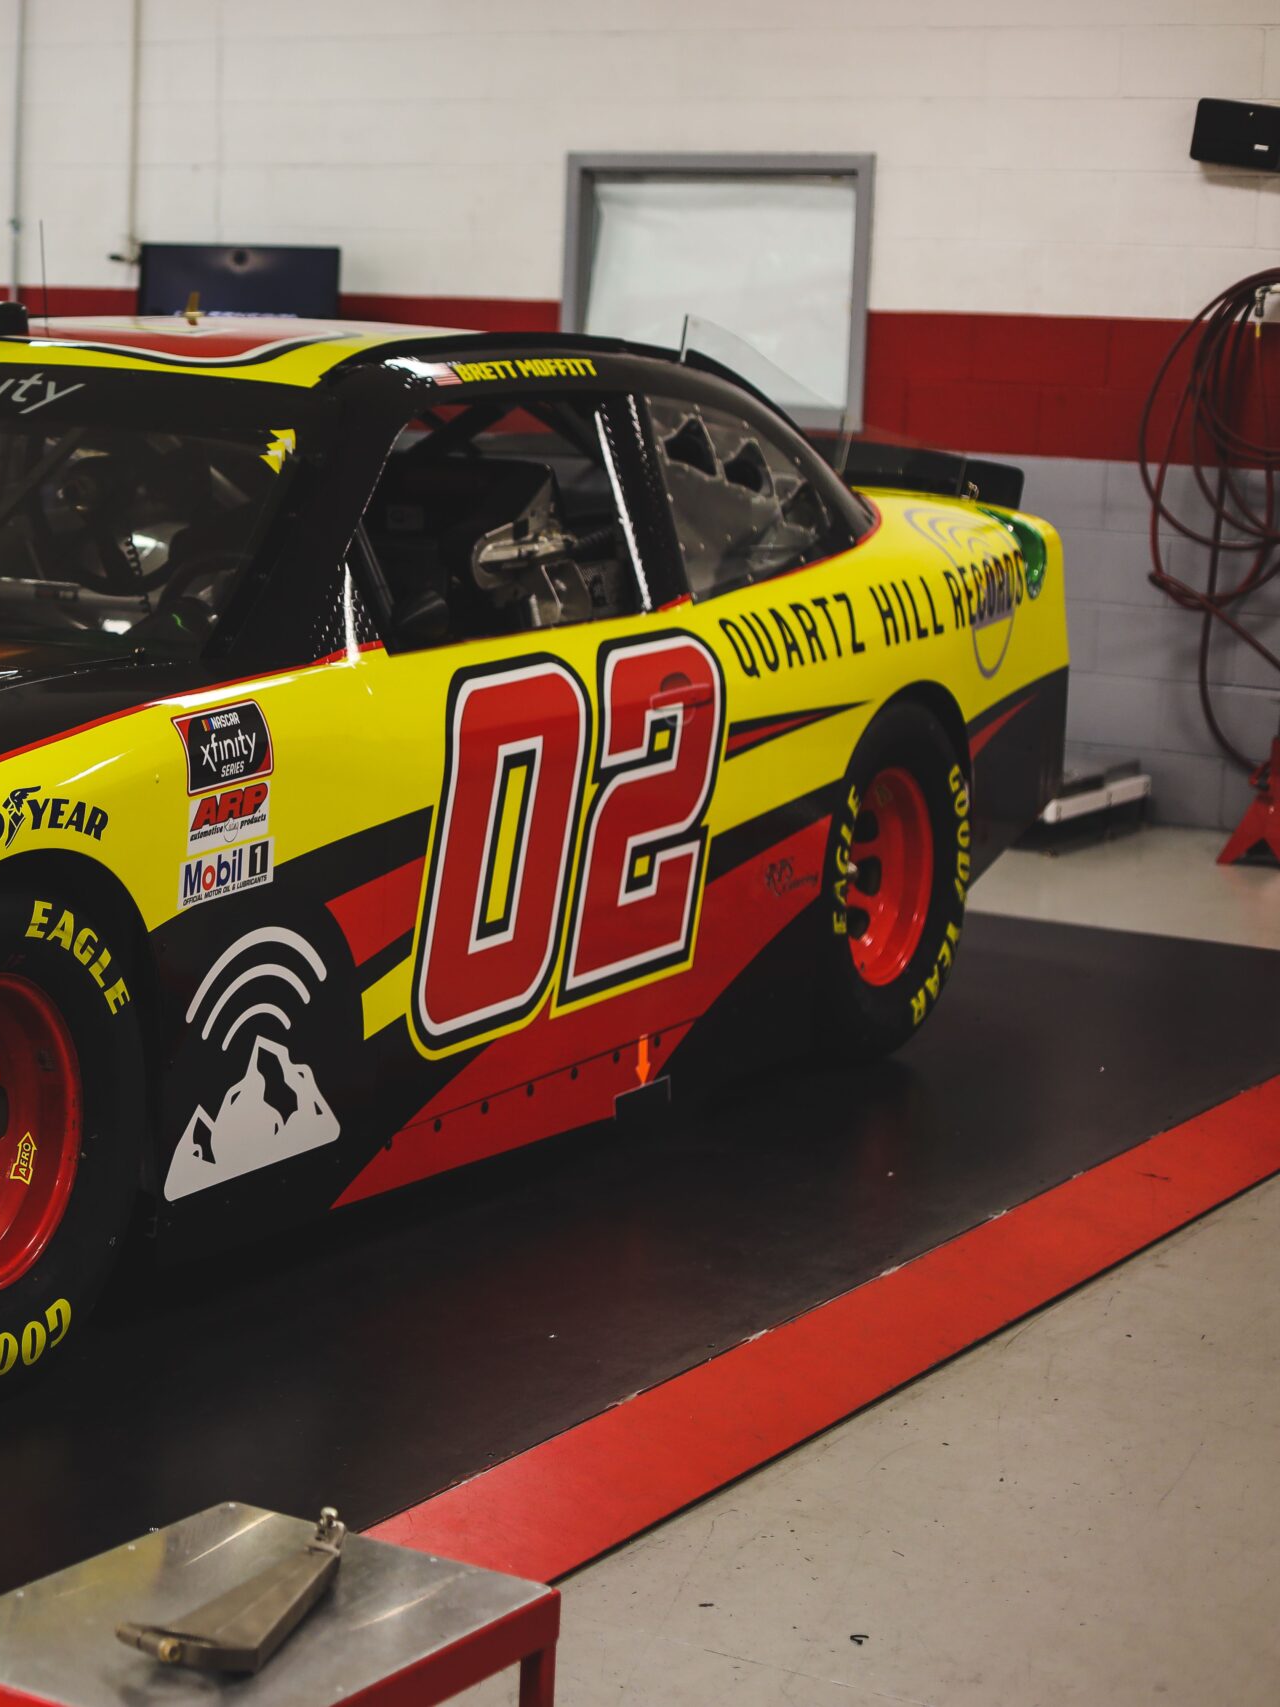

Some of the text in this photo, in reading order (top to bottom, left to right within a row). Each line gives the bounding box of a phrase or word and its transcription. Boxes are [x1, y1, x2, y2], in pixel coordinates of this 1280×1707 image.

[454, 358, 597, 382] BRETT MOFFITT
[718, 549, 1024, 679] QUARTZ HILL RECORDS
[211, 712, 240, 730] NASCAR
[200, 729, 256, 772] xfinity
[221, 761, 245, 778] SERIES
[190, 782, 268, 832] ARP
[190, 824, 223, 842] automotive
[239, 813, 267, 830] products
[412, 628, 726, 1050] 02
[833, 784, 861, 934] EAGLE
[183, 848, 243, 898] Mobil
[183, 895, 203, 906] OFFICIAL
[204, 887, 222, 899] MOTOR
[236, 874, 267, 889] LUBRICANTS
[24, 900, 130, 1015] EAGLE
[18, 1142, 32, 1177] AERO
